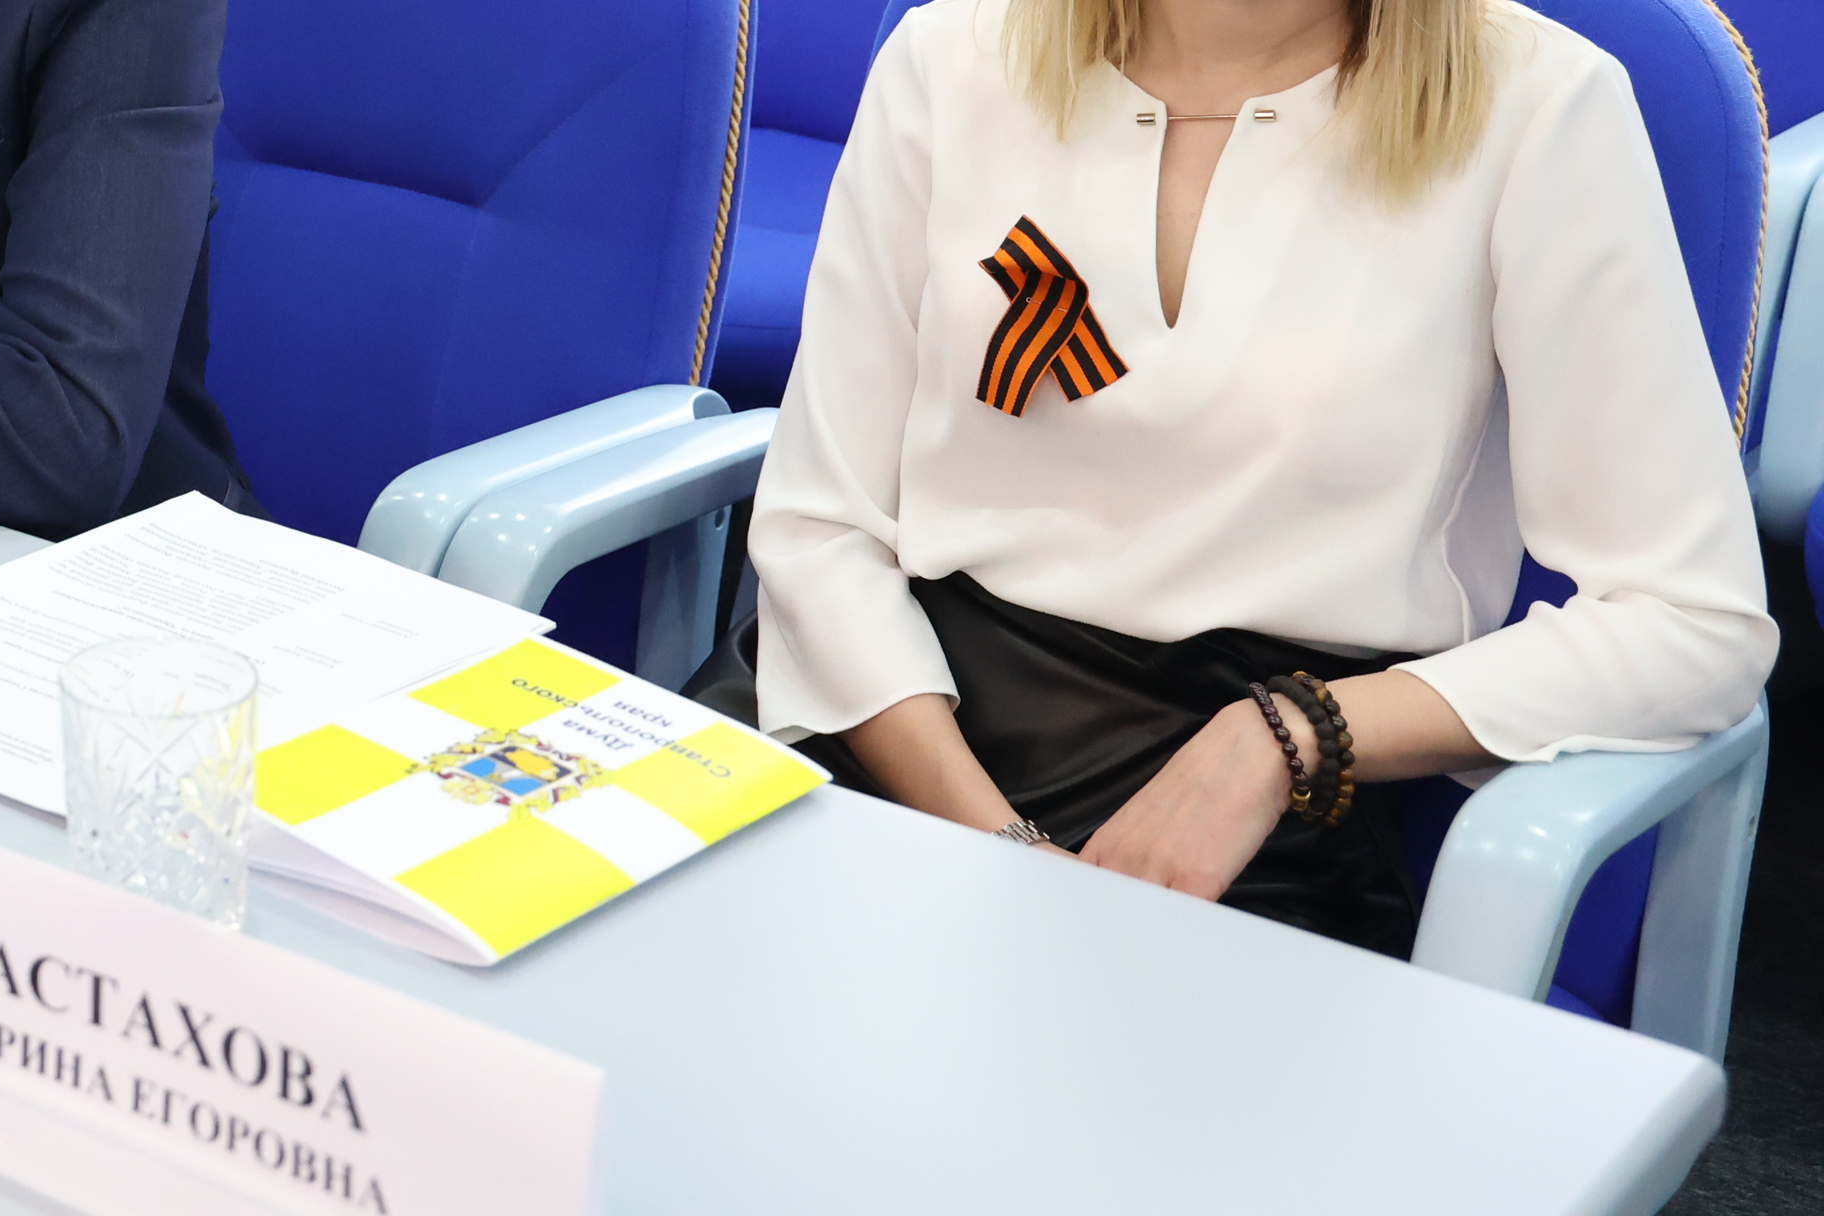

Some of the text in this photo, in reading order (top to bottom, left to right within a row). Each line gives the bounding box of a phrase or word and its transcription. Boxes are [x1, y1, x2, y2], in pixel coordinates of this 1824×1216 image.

[511, 678, 733, 779] Ставропольского
[563, 719, 636, 752] Дума
[612, 700, 674, 728] края
[129, 1076, 389, 1216] ЕГОРОВНА
